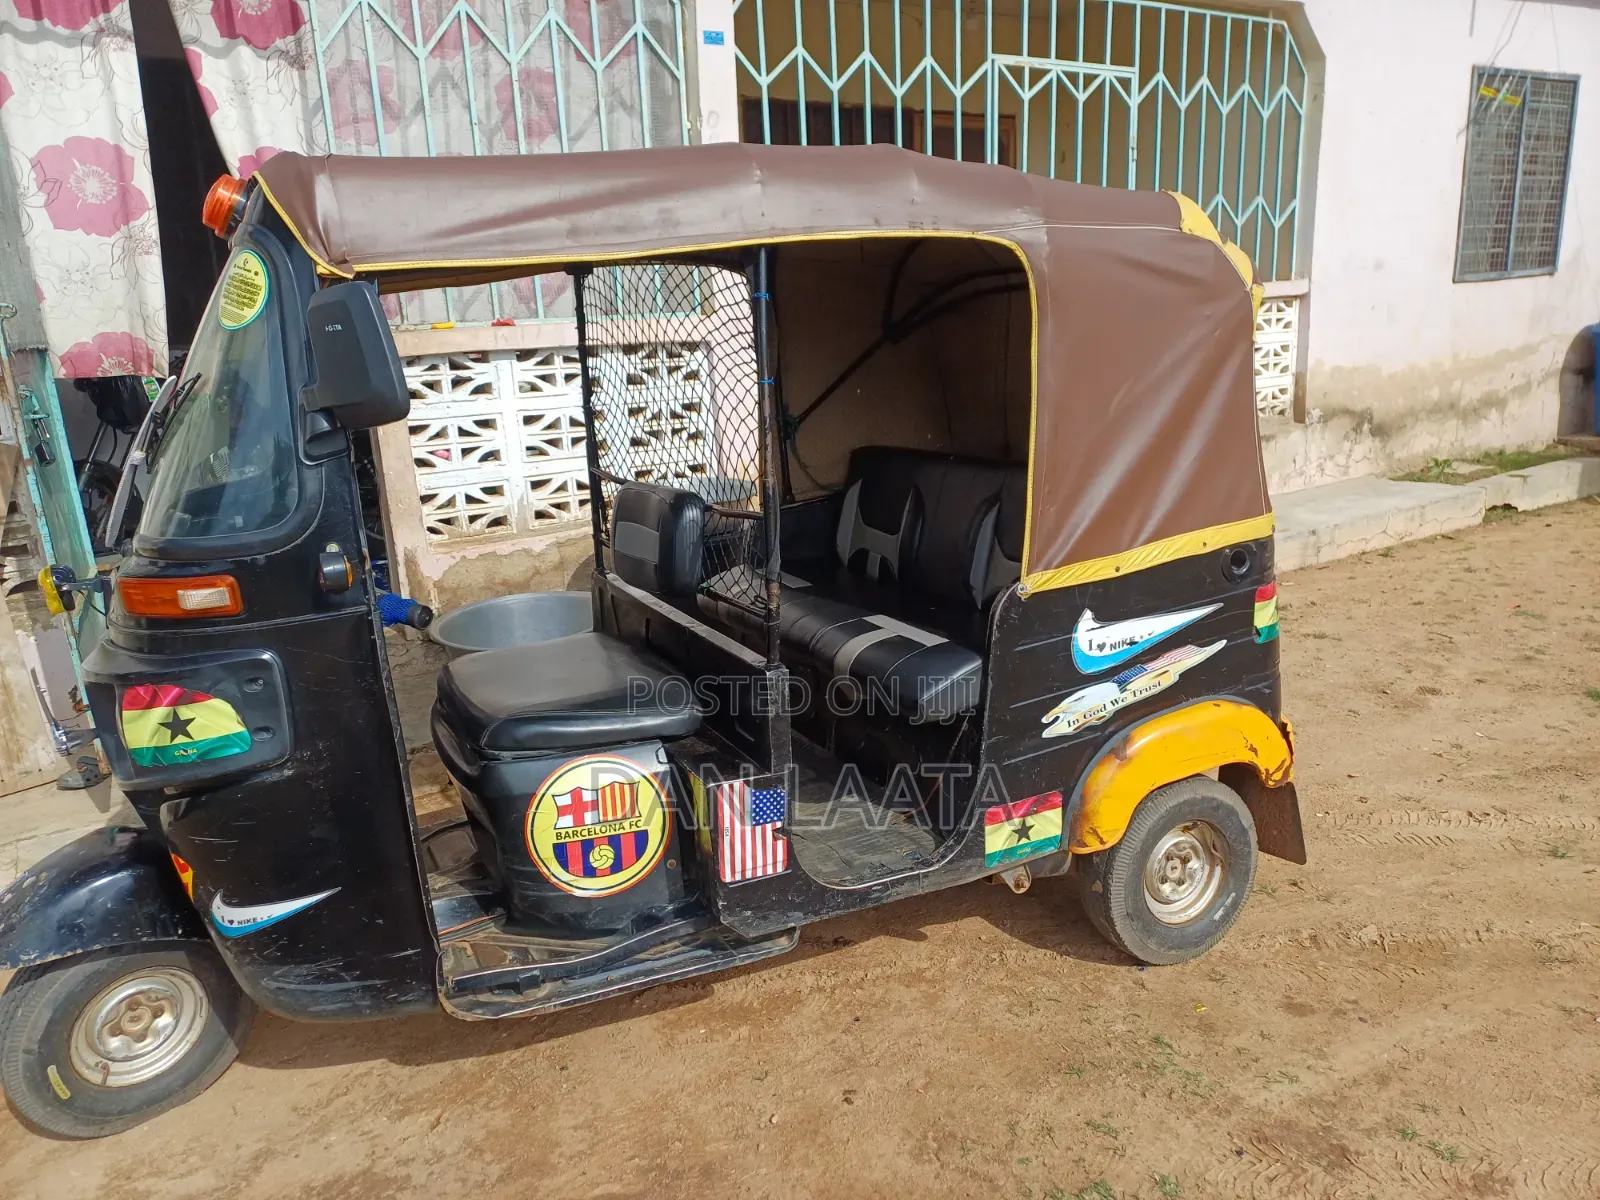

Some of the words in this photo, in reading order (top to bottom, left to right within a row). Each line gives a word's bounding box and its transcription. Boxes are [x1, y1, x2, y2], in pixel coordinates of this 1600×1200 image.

[1088, 638, 1093, 651] I
[1109, 636, 1136, 651] NIKE
[1066, 718, 1080, 728] In
[1083, 703, 1107, 720] God
[1109, 696, 1128, 707] We
[1130, 680, 1162, 698] Trust
[555, 822, 626, 841] BARCELONA
[629, 819, 642, 829] FC
[237, 916, 258, 926] NIKE
